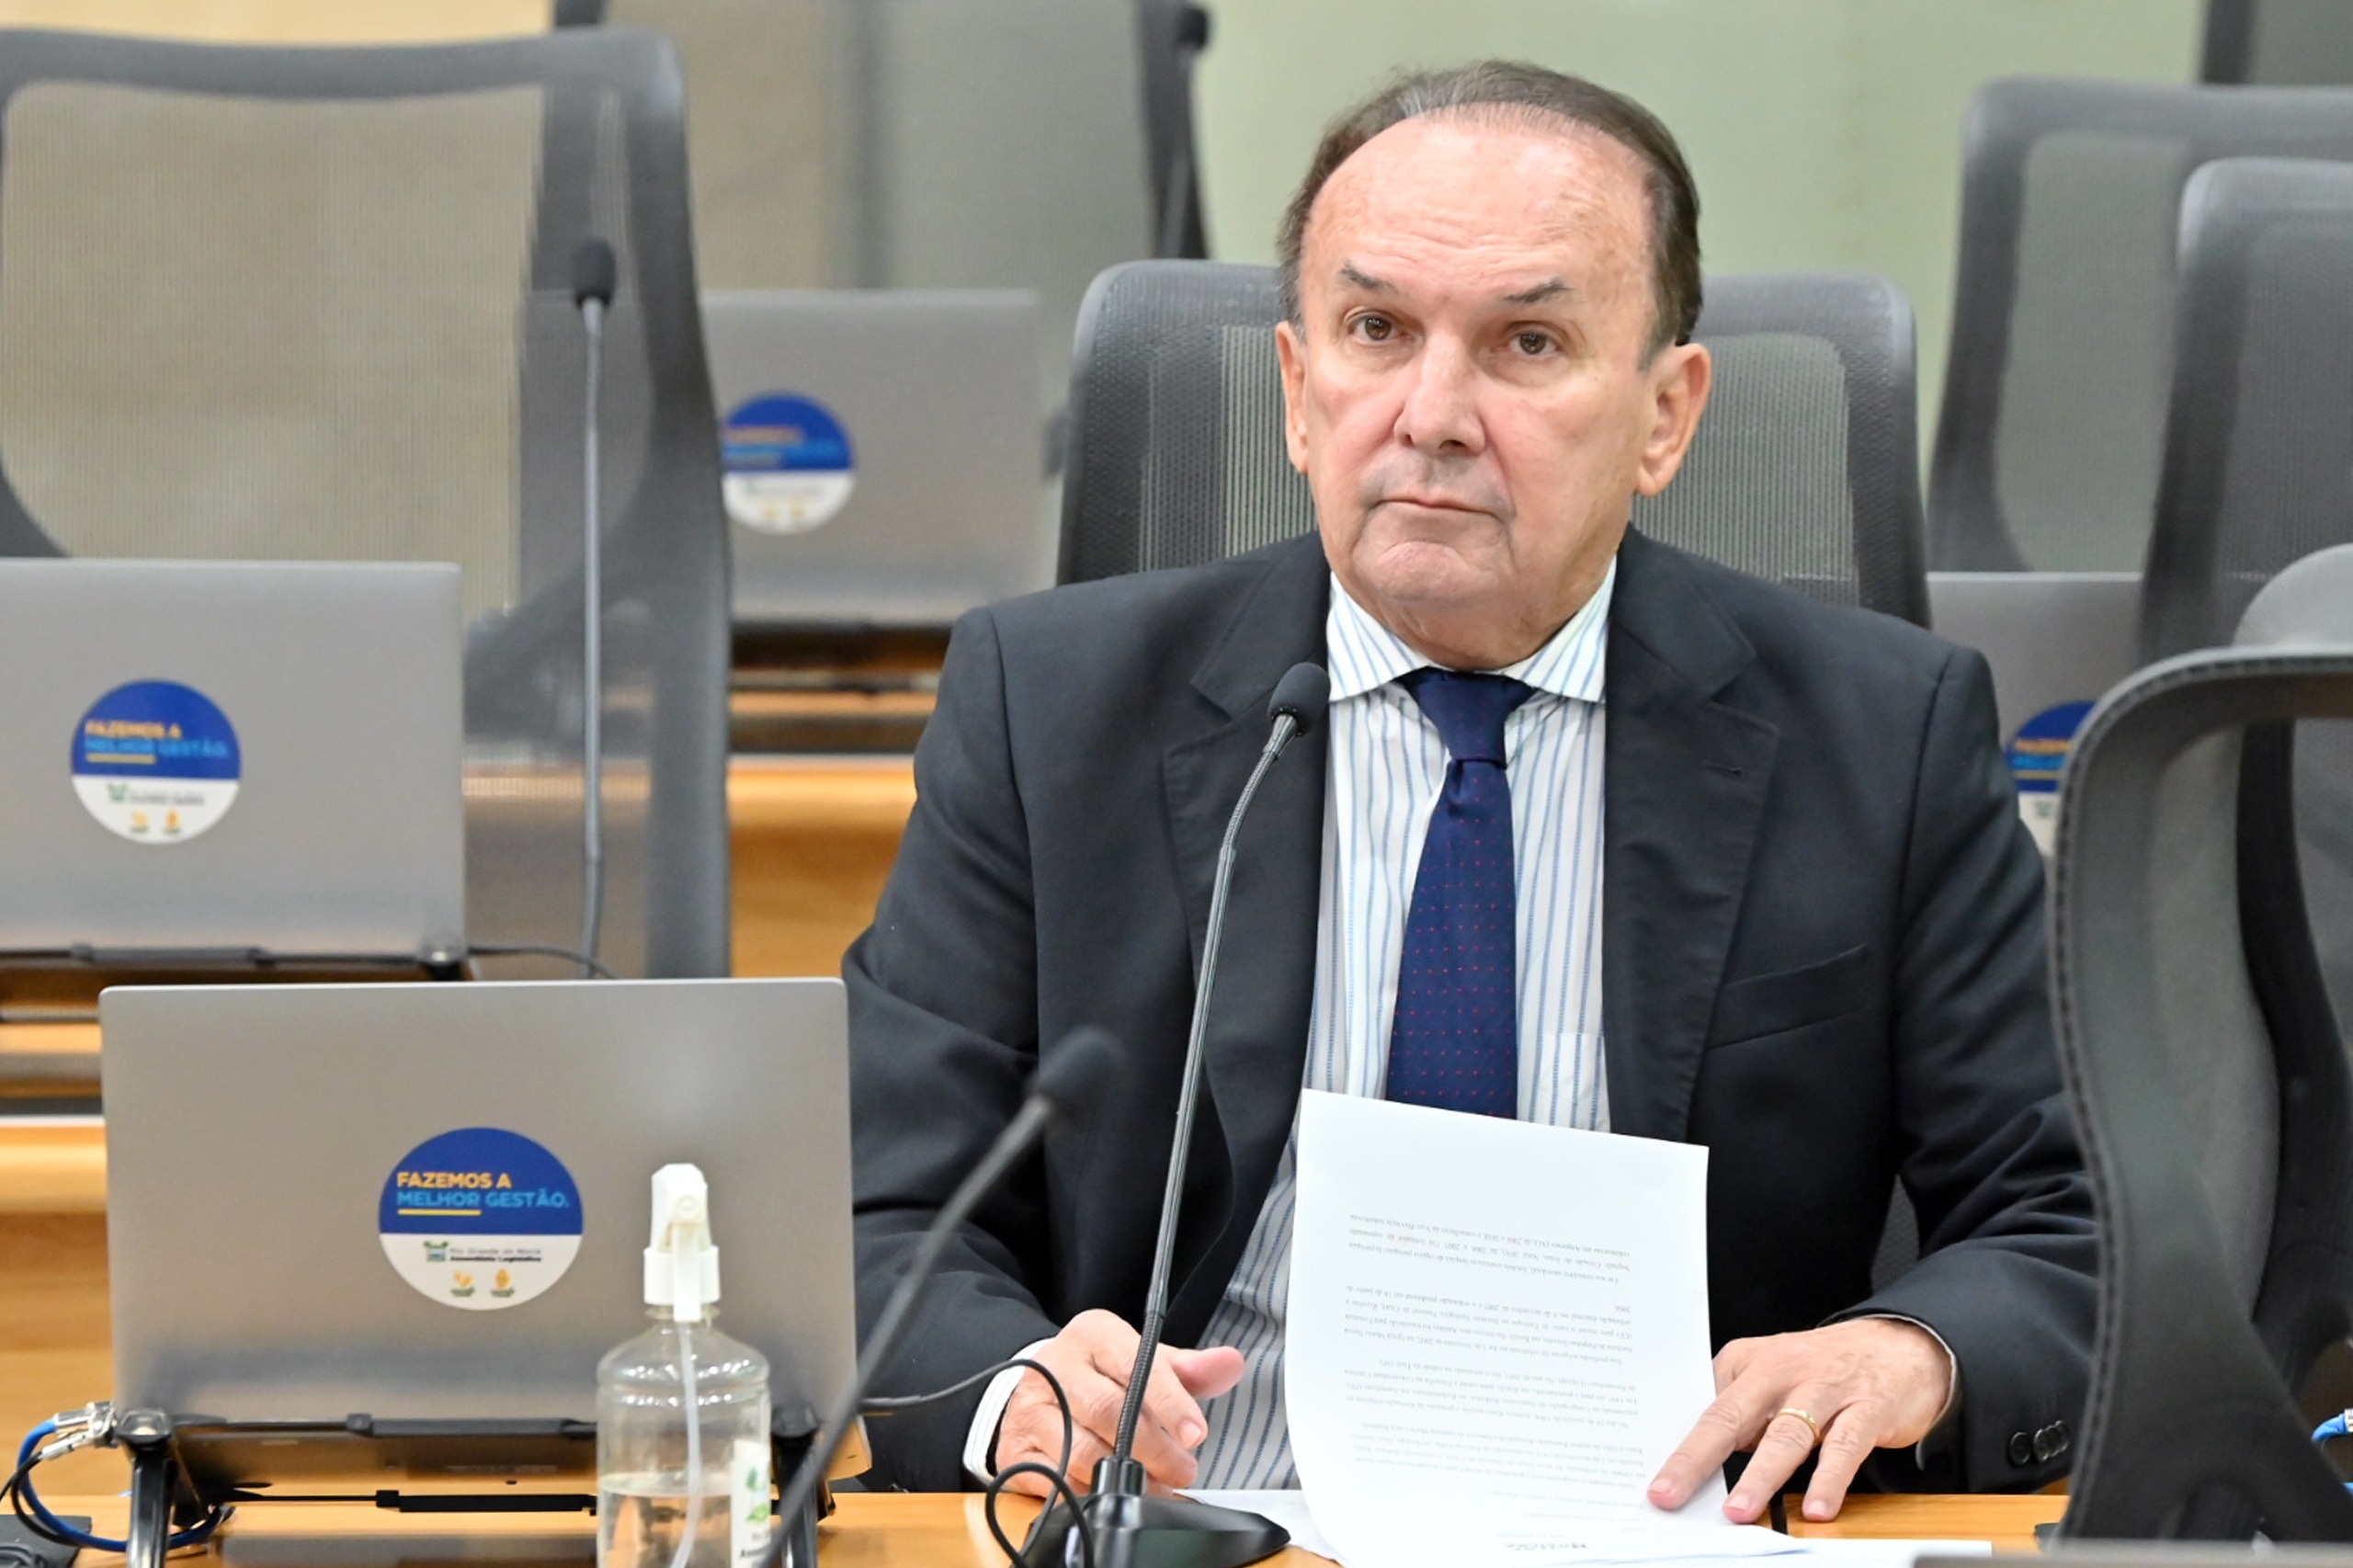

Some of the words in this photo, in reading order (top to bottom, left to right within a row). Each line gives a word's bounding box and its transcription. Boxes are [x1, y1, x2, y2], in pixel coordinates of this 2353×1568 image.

[397, 1172, 493, 1188] FAZEMOS
[496, 1173, 512, 1188] A
[397, 1191, 481, 1208] MELHOR
[484, 1187, 569, 1209] GESTÃO.
